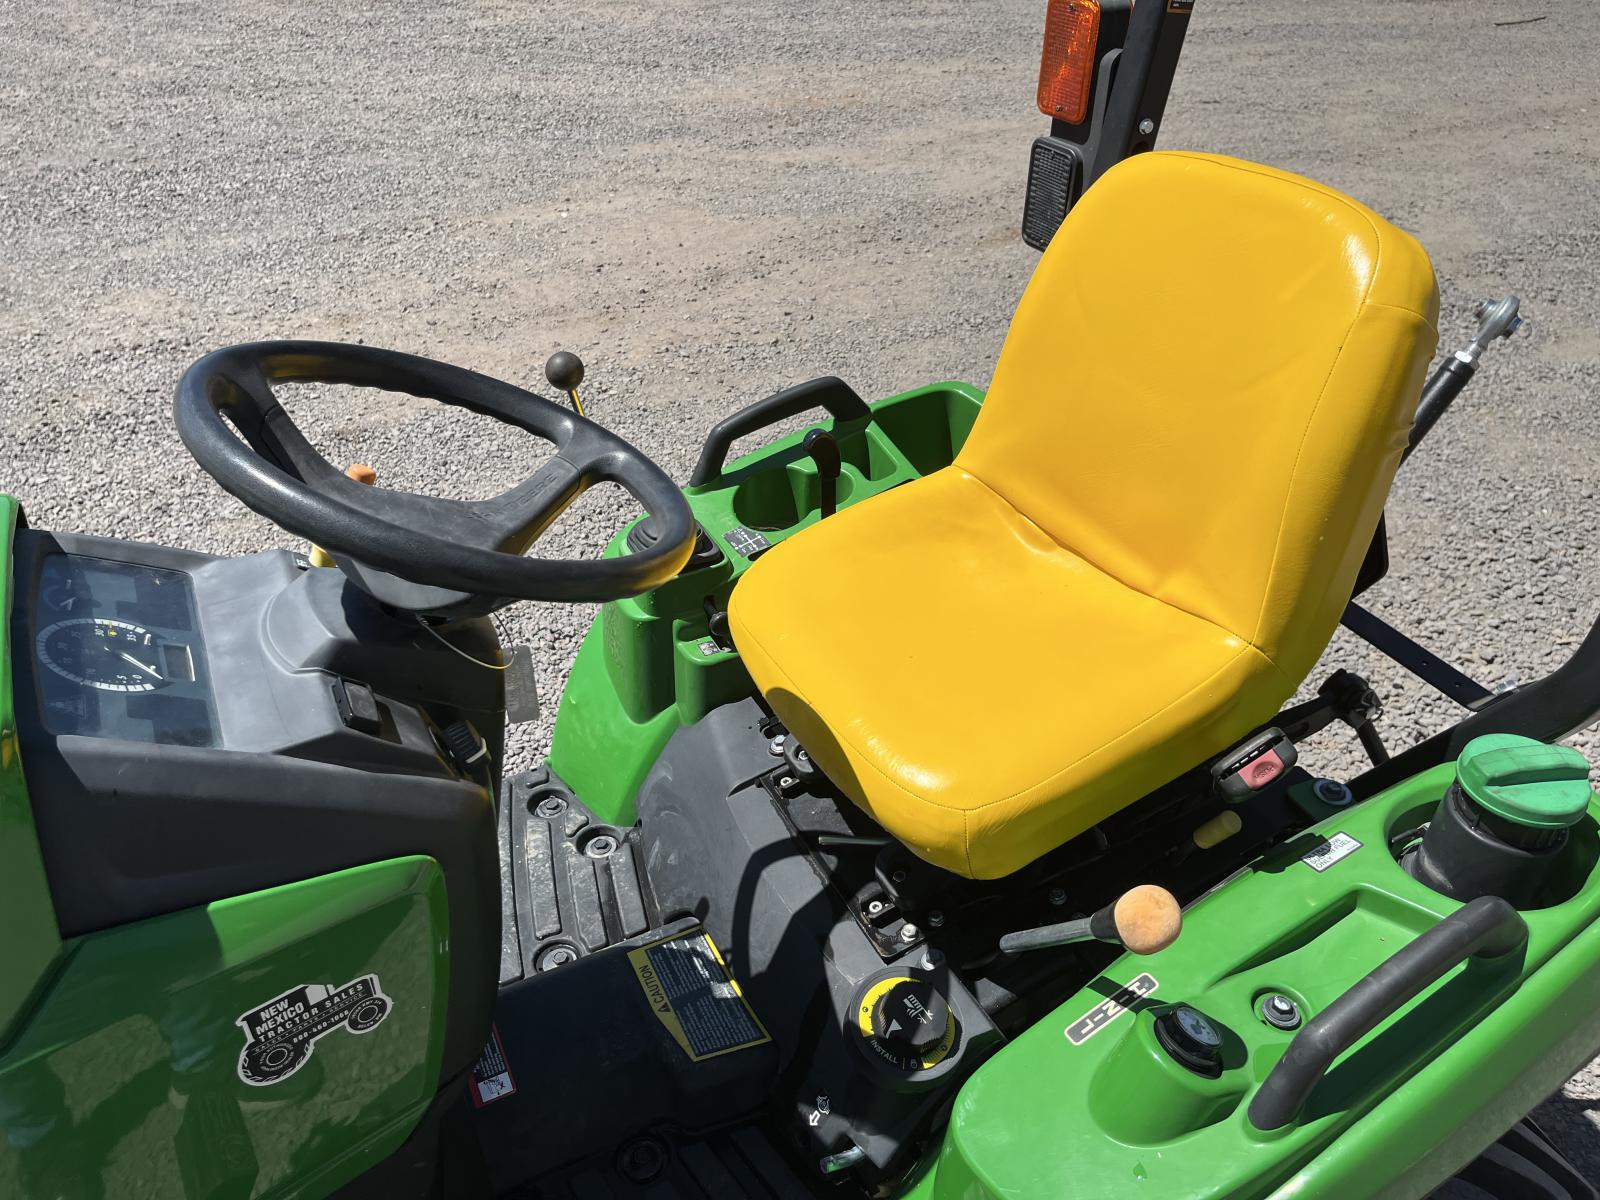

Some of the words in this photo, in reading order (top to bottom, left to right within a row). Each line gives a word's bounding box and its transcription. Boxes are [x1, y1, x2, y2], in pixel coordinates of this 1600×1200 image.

[639, 964, 664, 1003] CAUTION
[255, 1002, 305, 1035] MEXICO
[258, 1007, 319, 1043] TRACTOR
[325, 983, 363, 1008] SALES
[260, 999, 289, 1021] NEW
[870, 1039, 899, 1064] INSTALL
